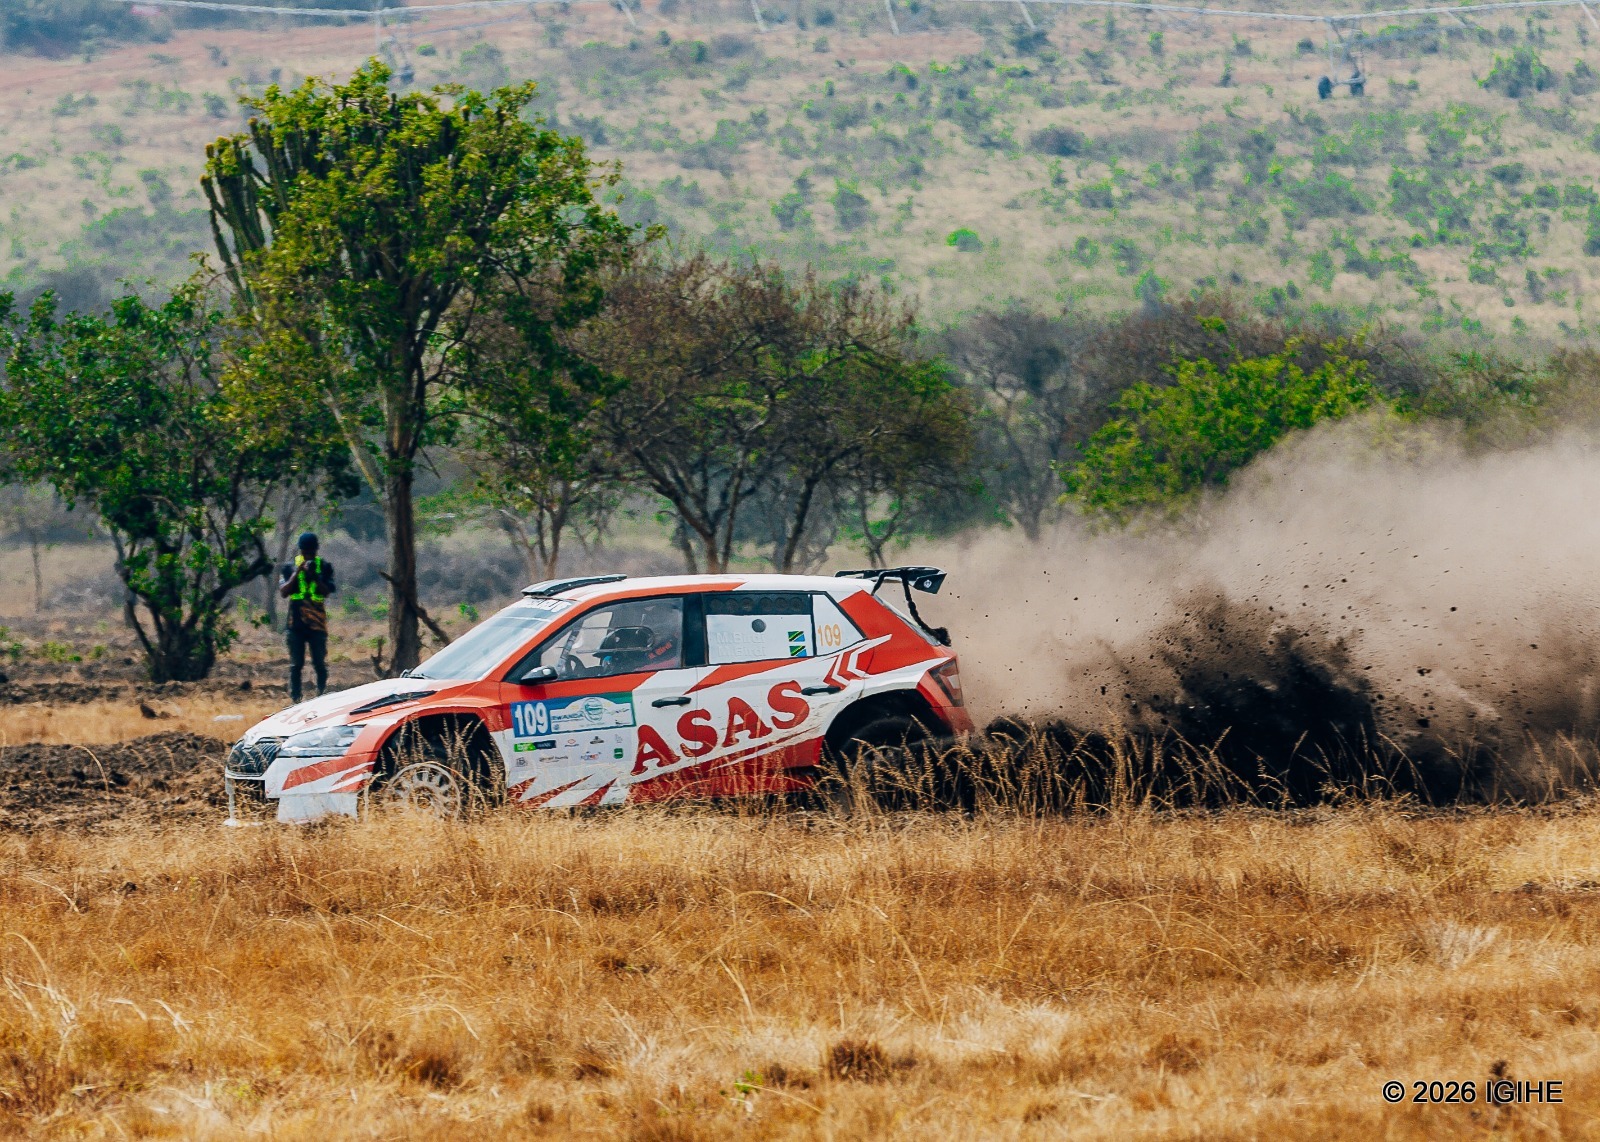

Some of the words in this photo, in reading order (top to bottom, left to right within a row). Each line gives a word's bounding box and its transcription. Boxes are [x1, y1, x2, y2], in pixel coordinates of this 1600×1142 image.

[817, 623, 842, 647] 109
[515, 702, 549, 736] 109
[630, 680, 810, 776] ASAS
